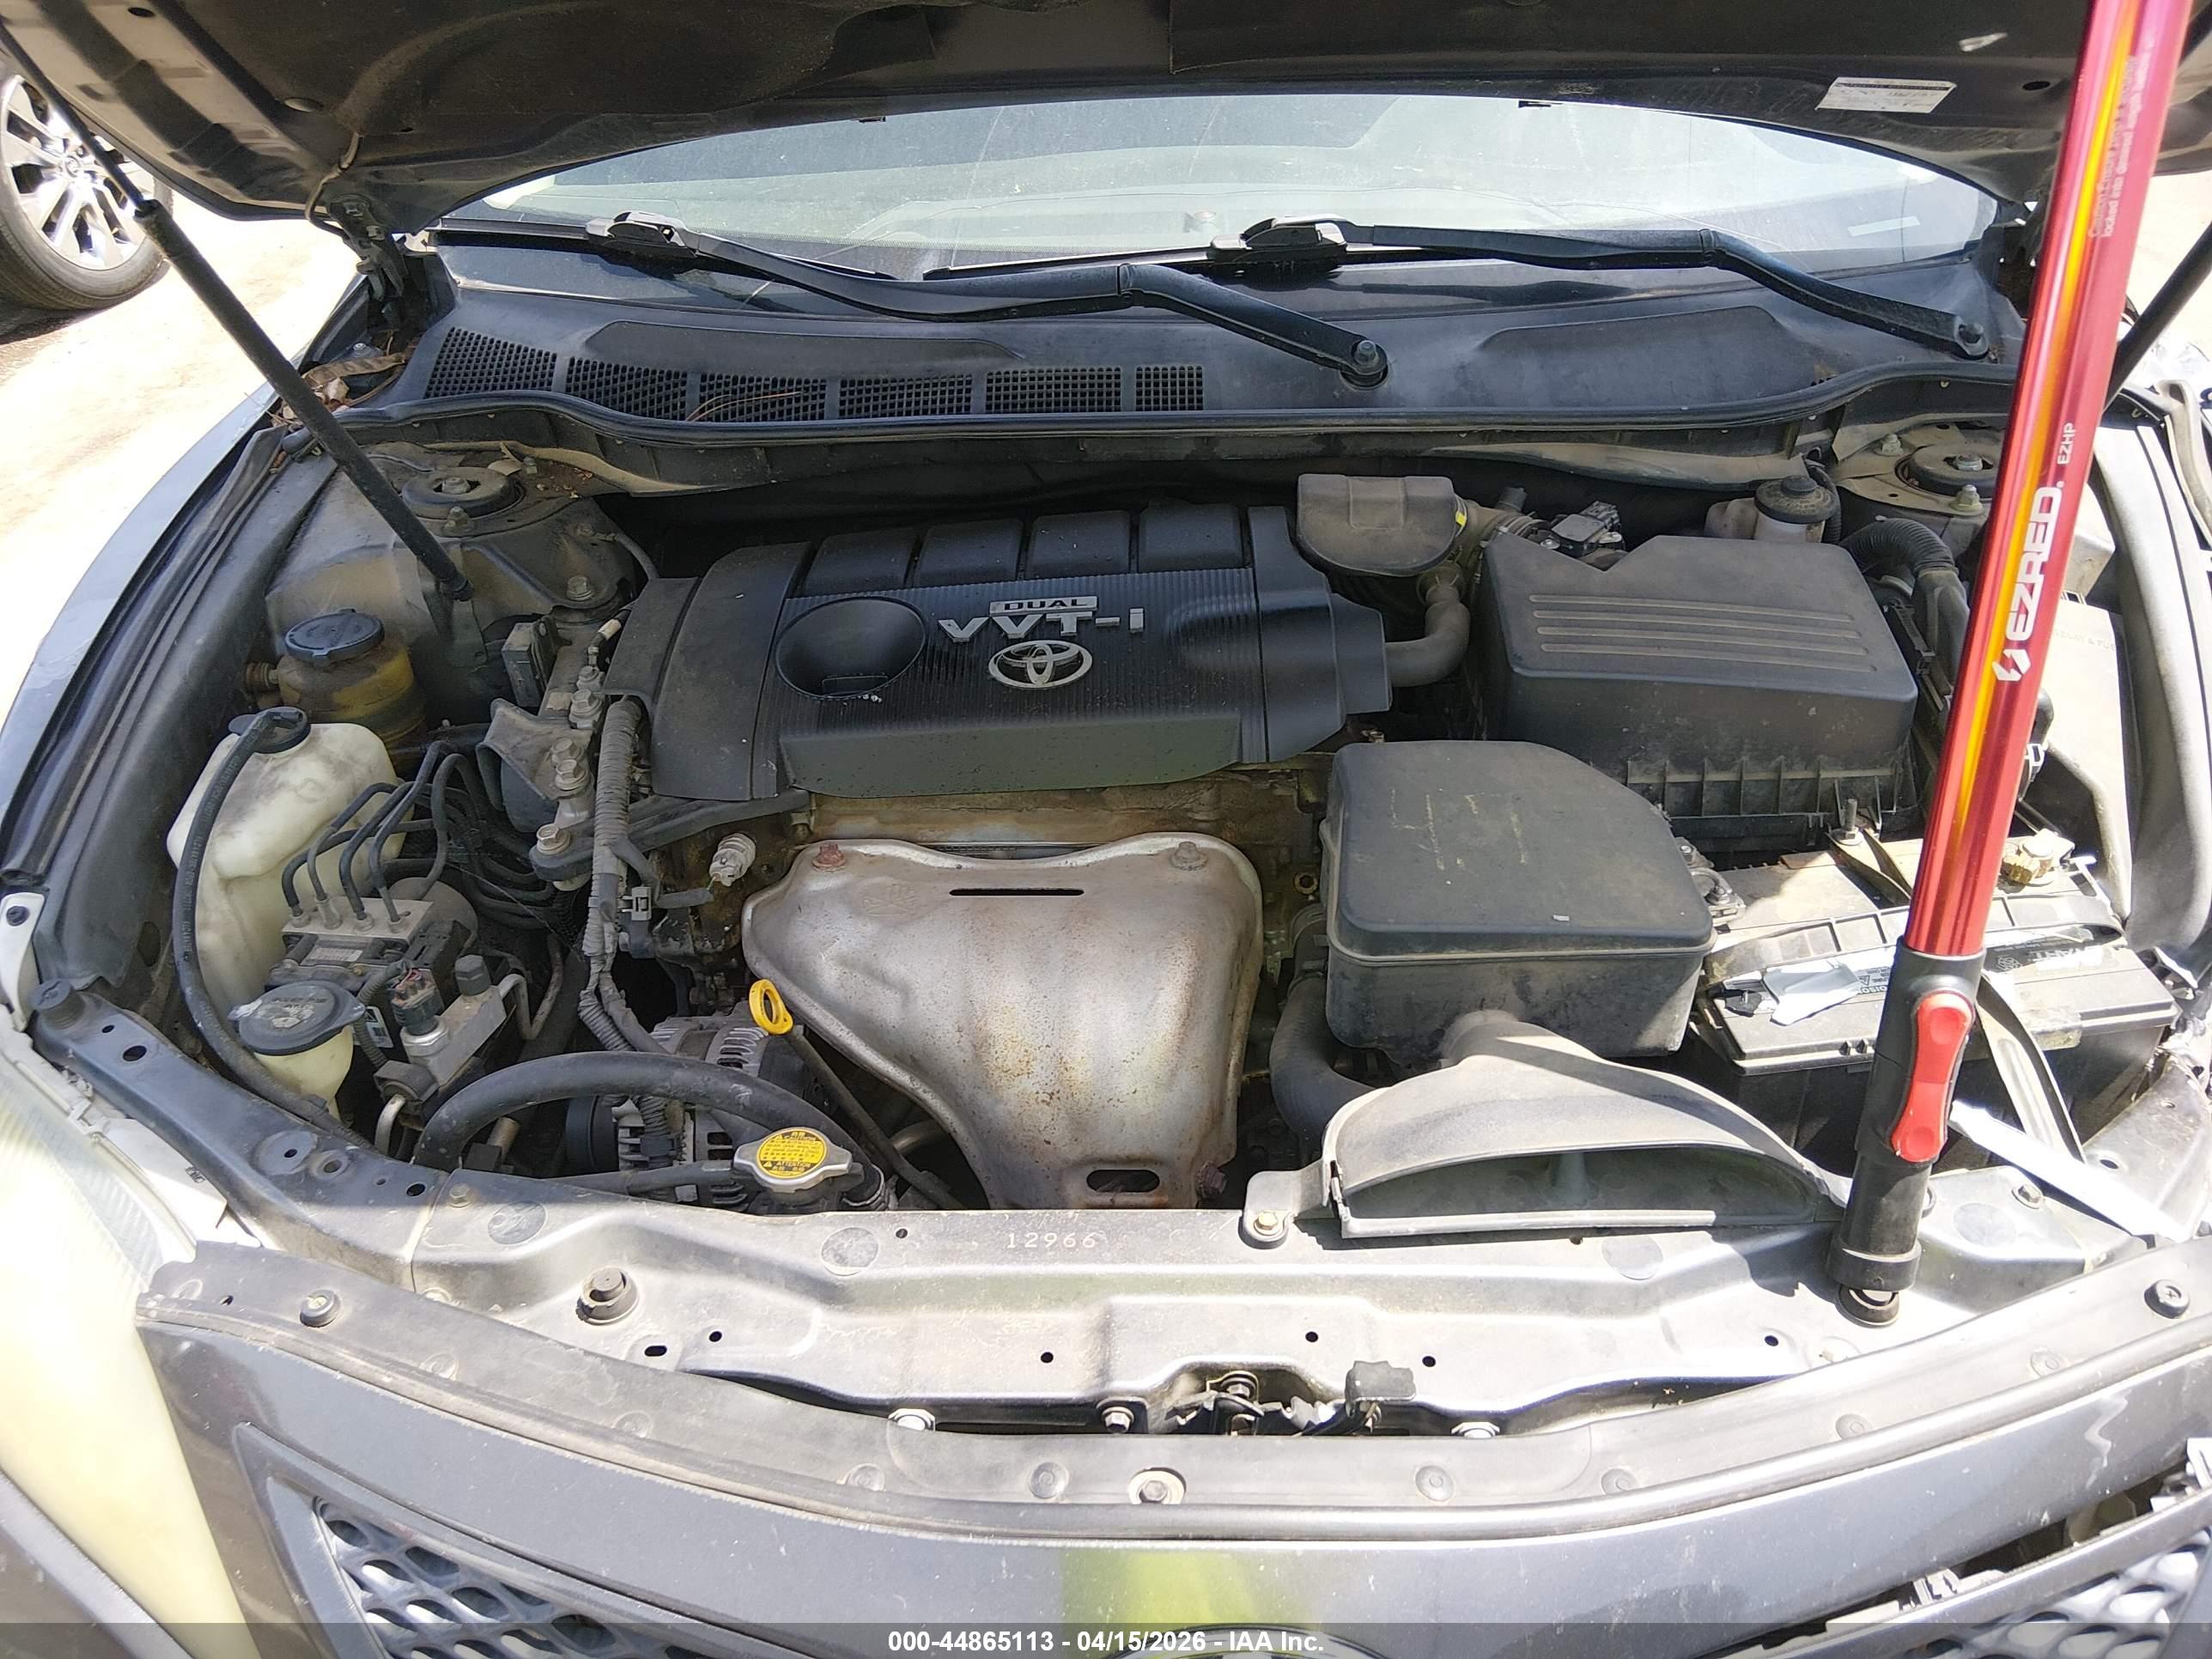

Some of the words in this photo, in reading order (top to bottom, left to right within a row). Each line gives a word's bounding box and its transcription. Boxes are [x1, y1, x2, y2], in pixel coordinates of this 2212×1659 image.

[2057, 422, 2075, 465] EZHP
[2006, 486, 2063, 641] EZRED
[1003, 598, 1089, 611] DUAL
[1006, 1231, 1097, 1249] 12966
